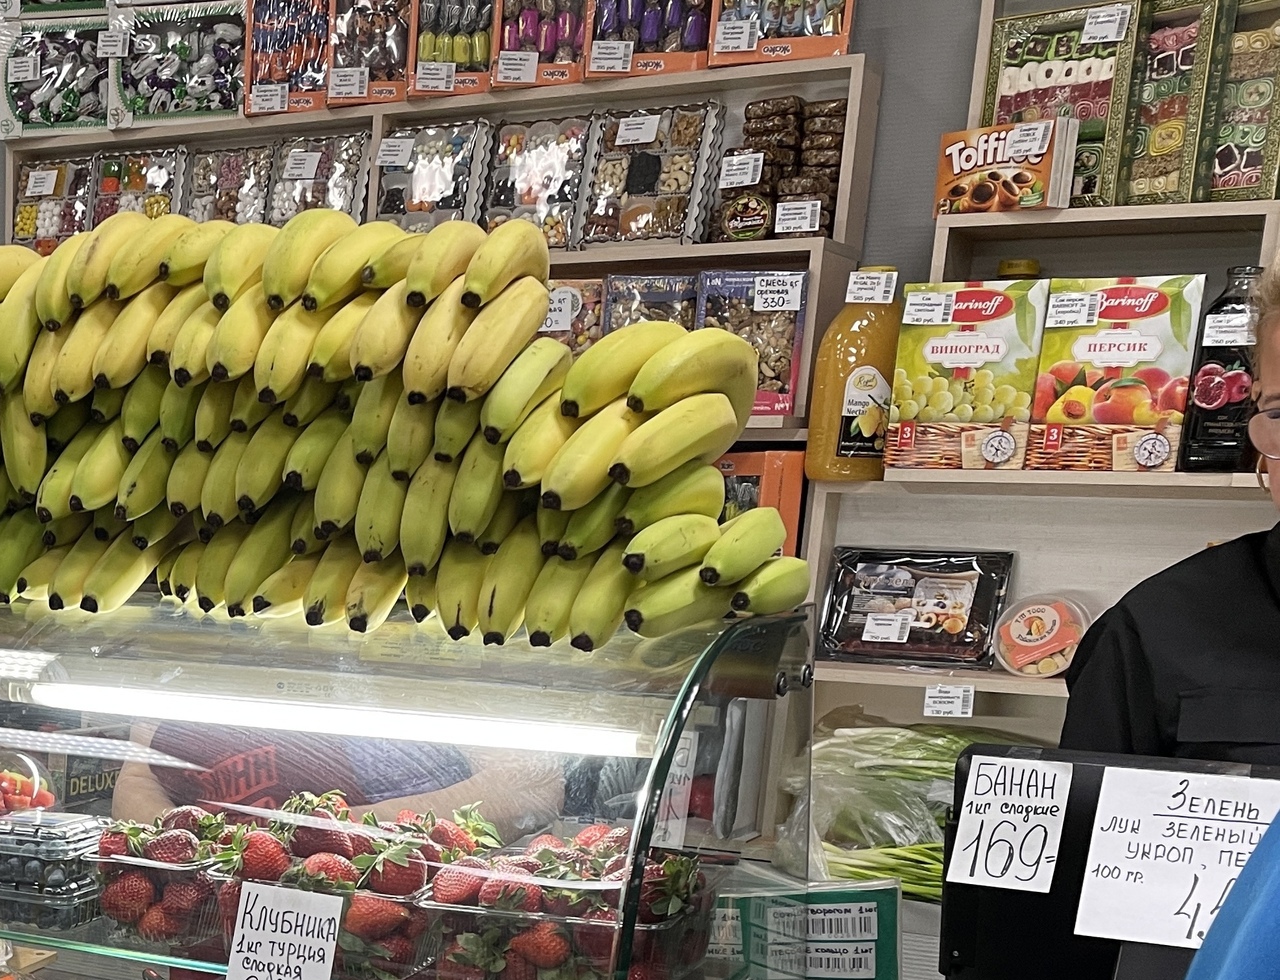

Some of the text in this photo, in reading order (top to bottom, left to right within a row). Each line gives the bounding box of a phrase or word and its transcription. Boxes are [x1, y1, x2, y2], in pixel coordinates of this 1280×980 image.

[952, 296, 1003, 316] arinoff
[1097, 291, 1158, 313] Barinoff
[931, 344, 1000, 354] ВИНОГРАД
[1087, 342, 1148, 353] ПЕРСИК
[848, 399, 869, 409] Mango
[903, 426, 912, 439] 3
[1049, 428, 1058, 441] 3
[974, 762, 1057, 800] БАНАН
[1167, 779, 1261, 821] ЗЕЛЕНЬ
[1000, 802, 1060, 822] сладкие
[1100, 816, 1141, 835] ЛУК
[1091, 863, 1120, 880] 100
[241, 892, 336, 942] КЛУБНИКА
[269, 940, 326, 965] ТУРЦИЯ
